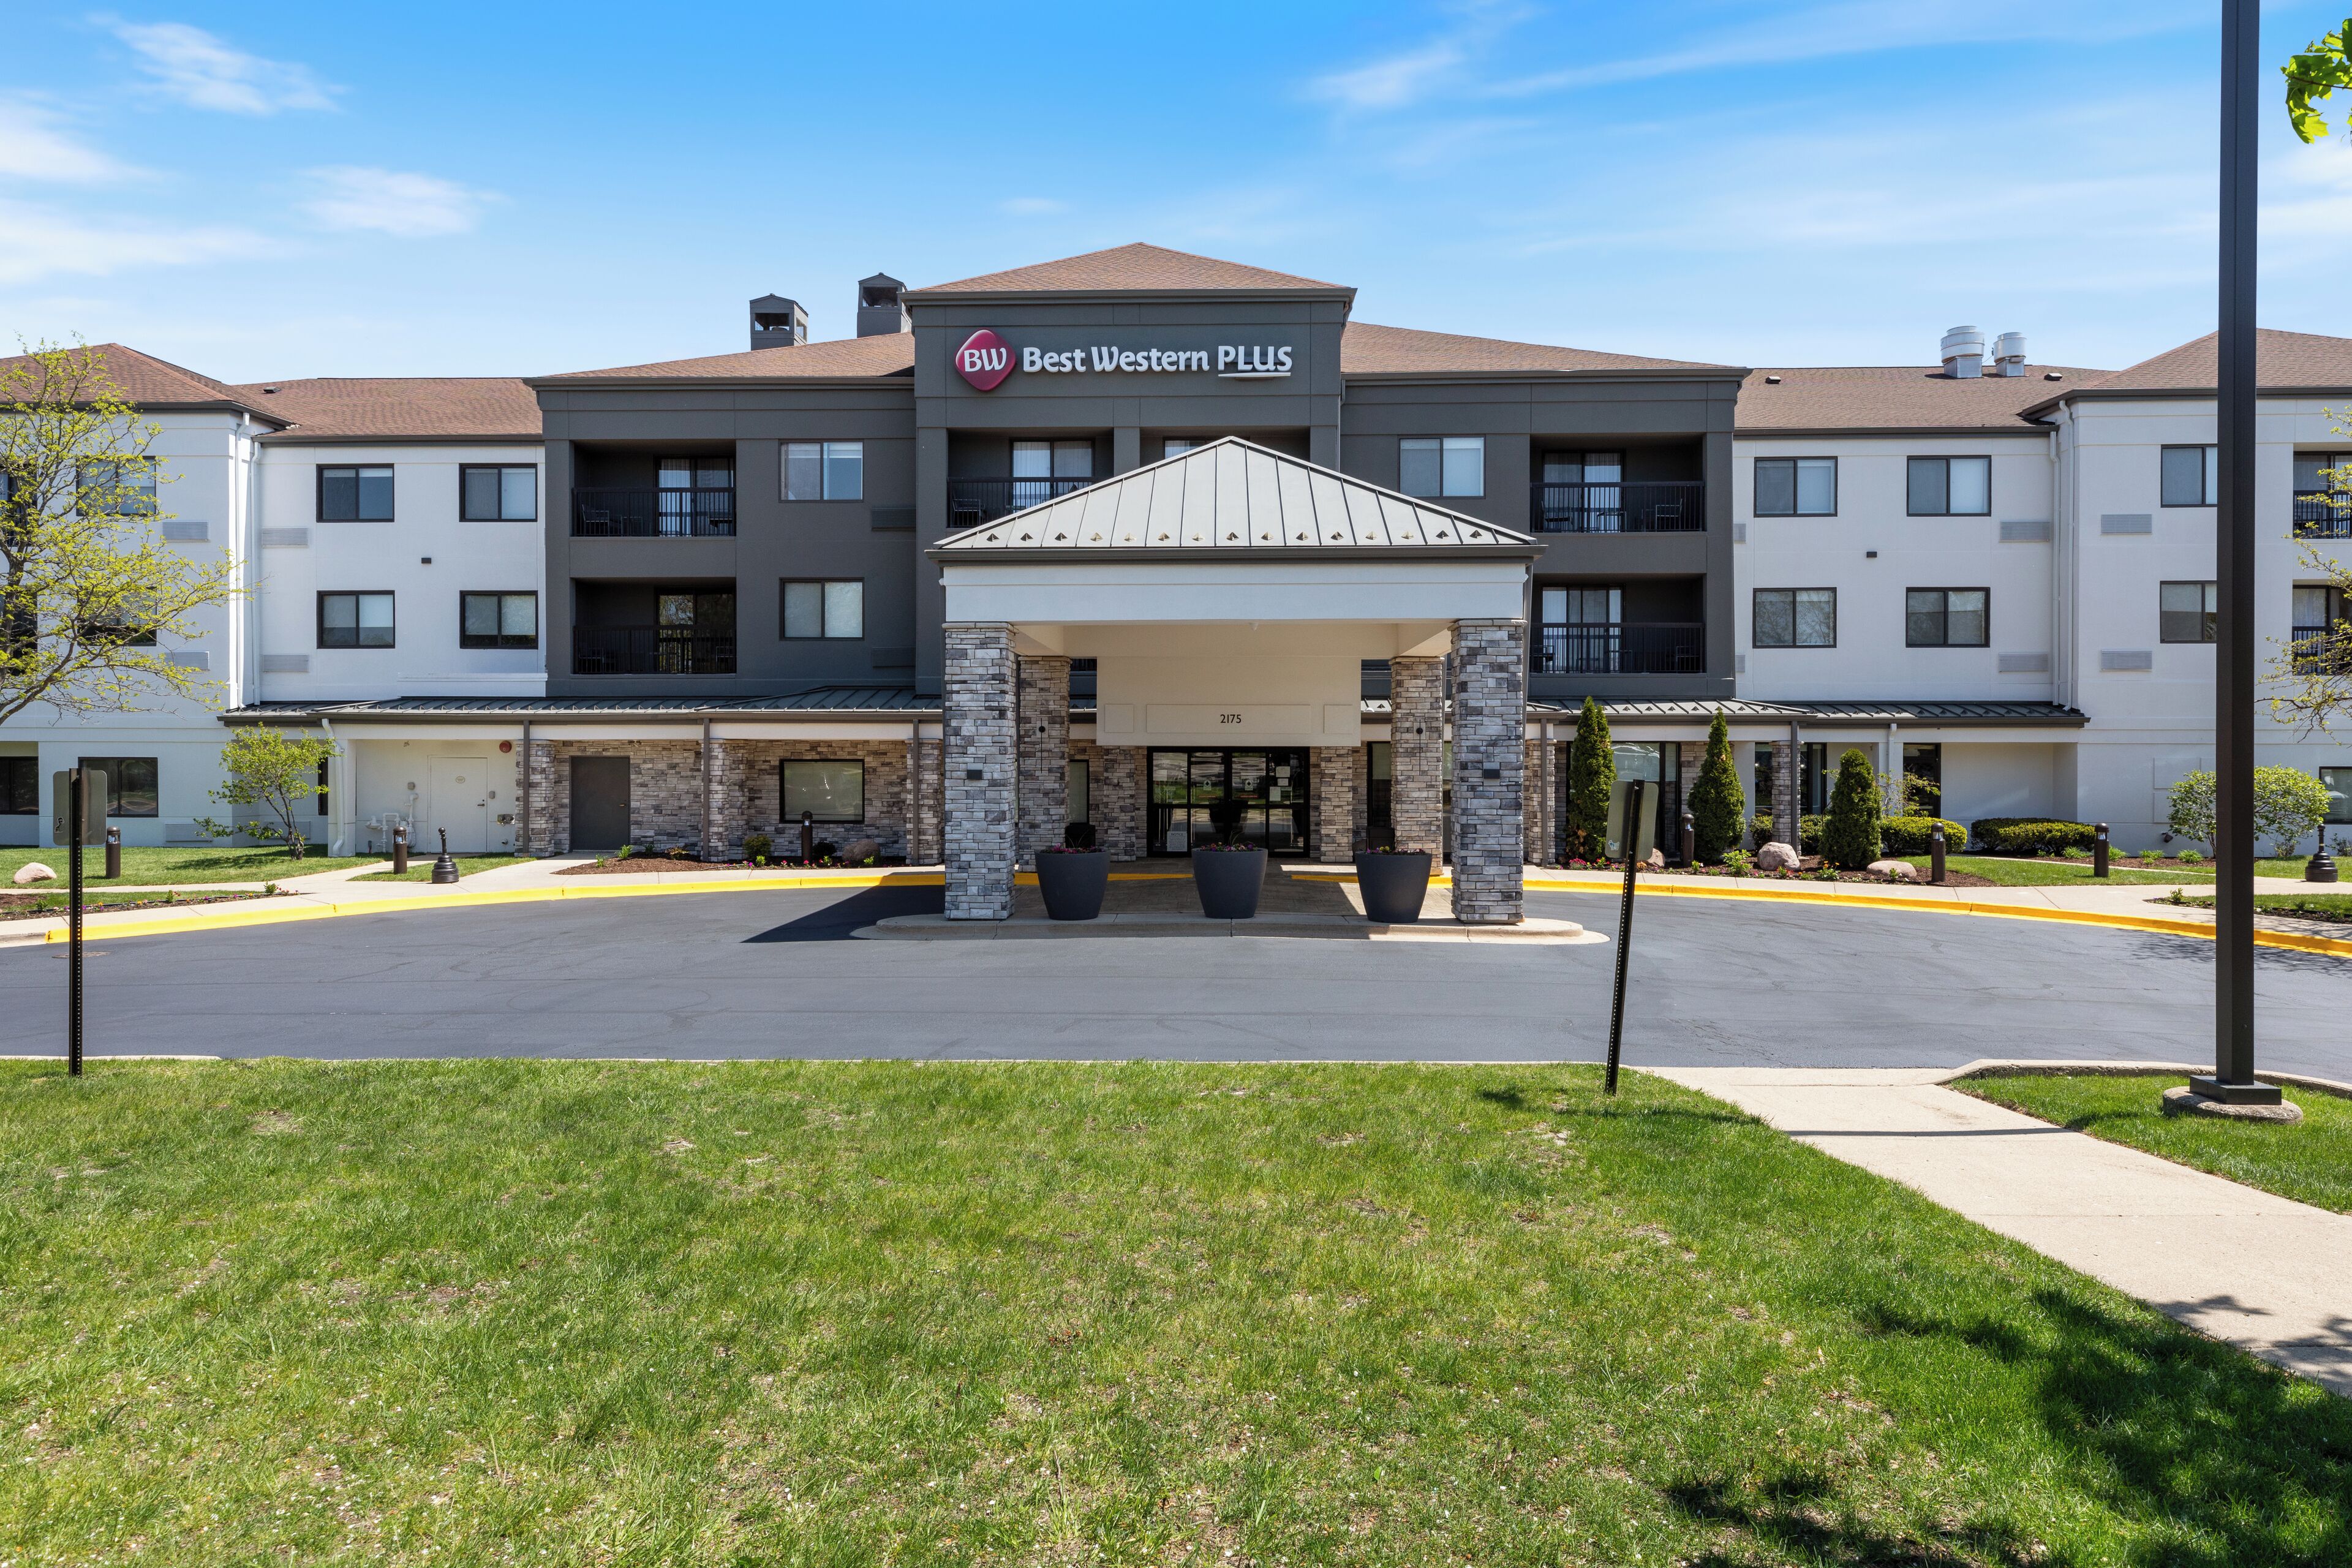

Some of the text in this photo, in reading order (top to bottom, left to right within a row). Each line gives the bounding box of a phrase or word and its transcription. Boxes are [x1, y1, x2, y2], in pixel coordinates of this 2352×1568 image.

[964, 347, 1007, 372] BW
[1023, 345, 1293, 372] Best Western PLUS
[1220, 714, 1242, 723] 2175
